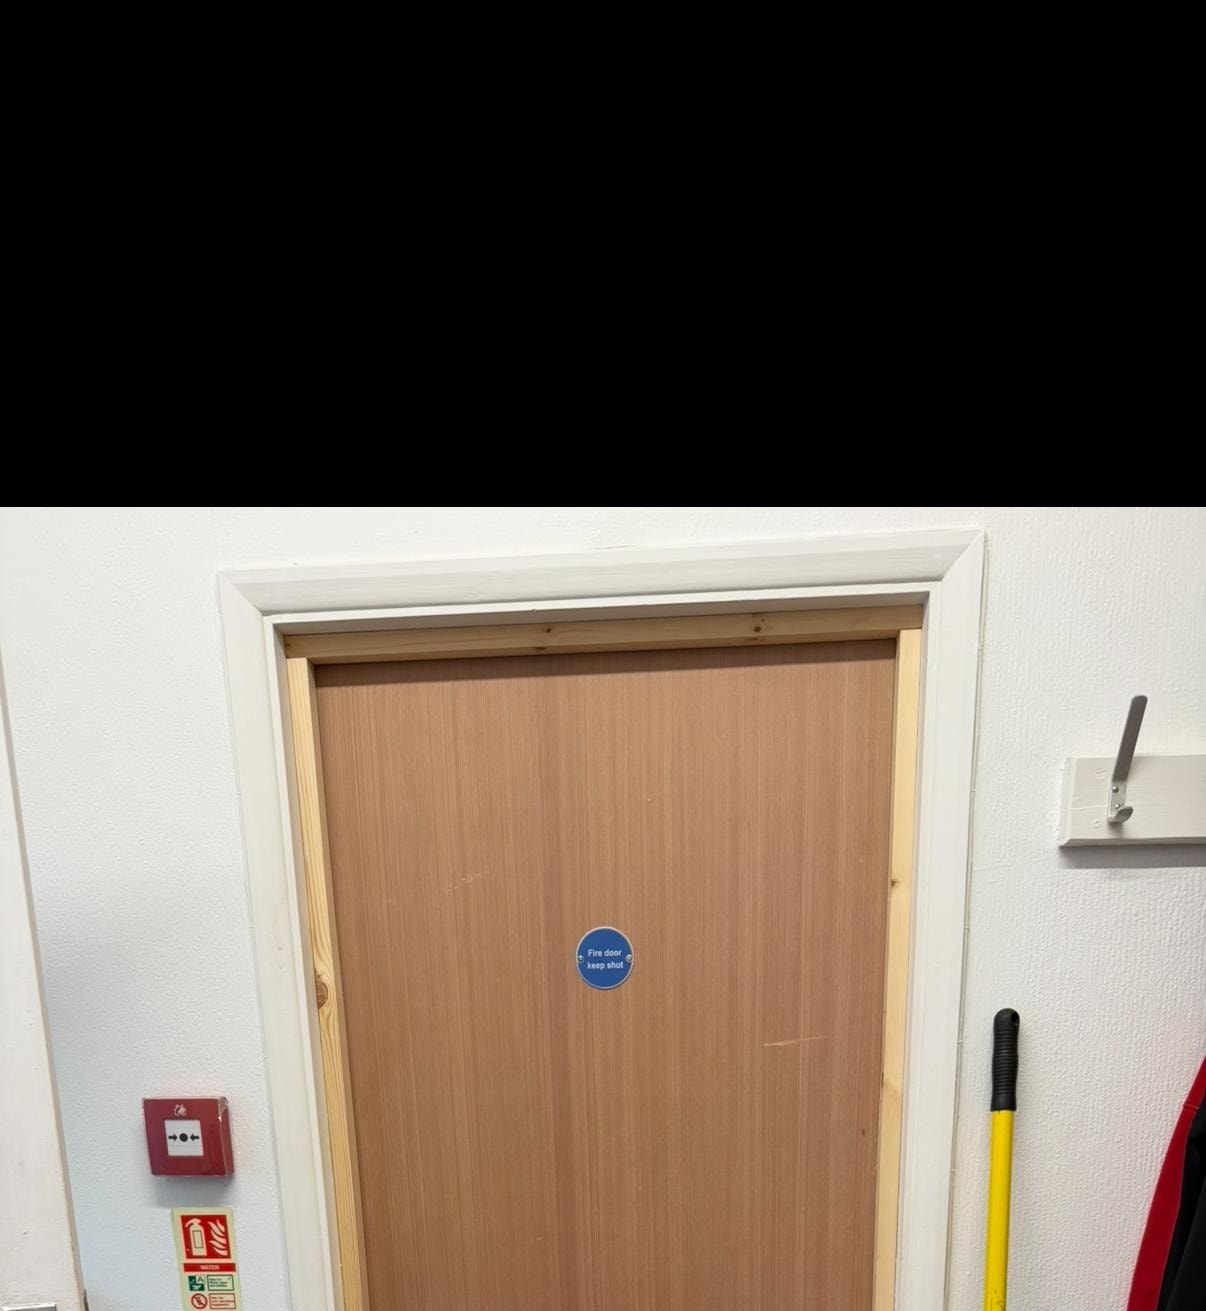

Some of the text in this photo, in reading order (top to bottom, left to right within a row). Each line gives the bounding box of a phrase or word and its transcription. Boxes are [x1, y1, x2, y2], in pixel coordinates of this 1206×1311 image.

[588, 948, 622, 957] Fire door
[588, 961, 624, 971] keep shut
